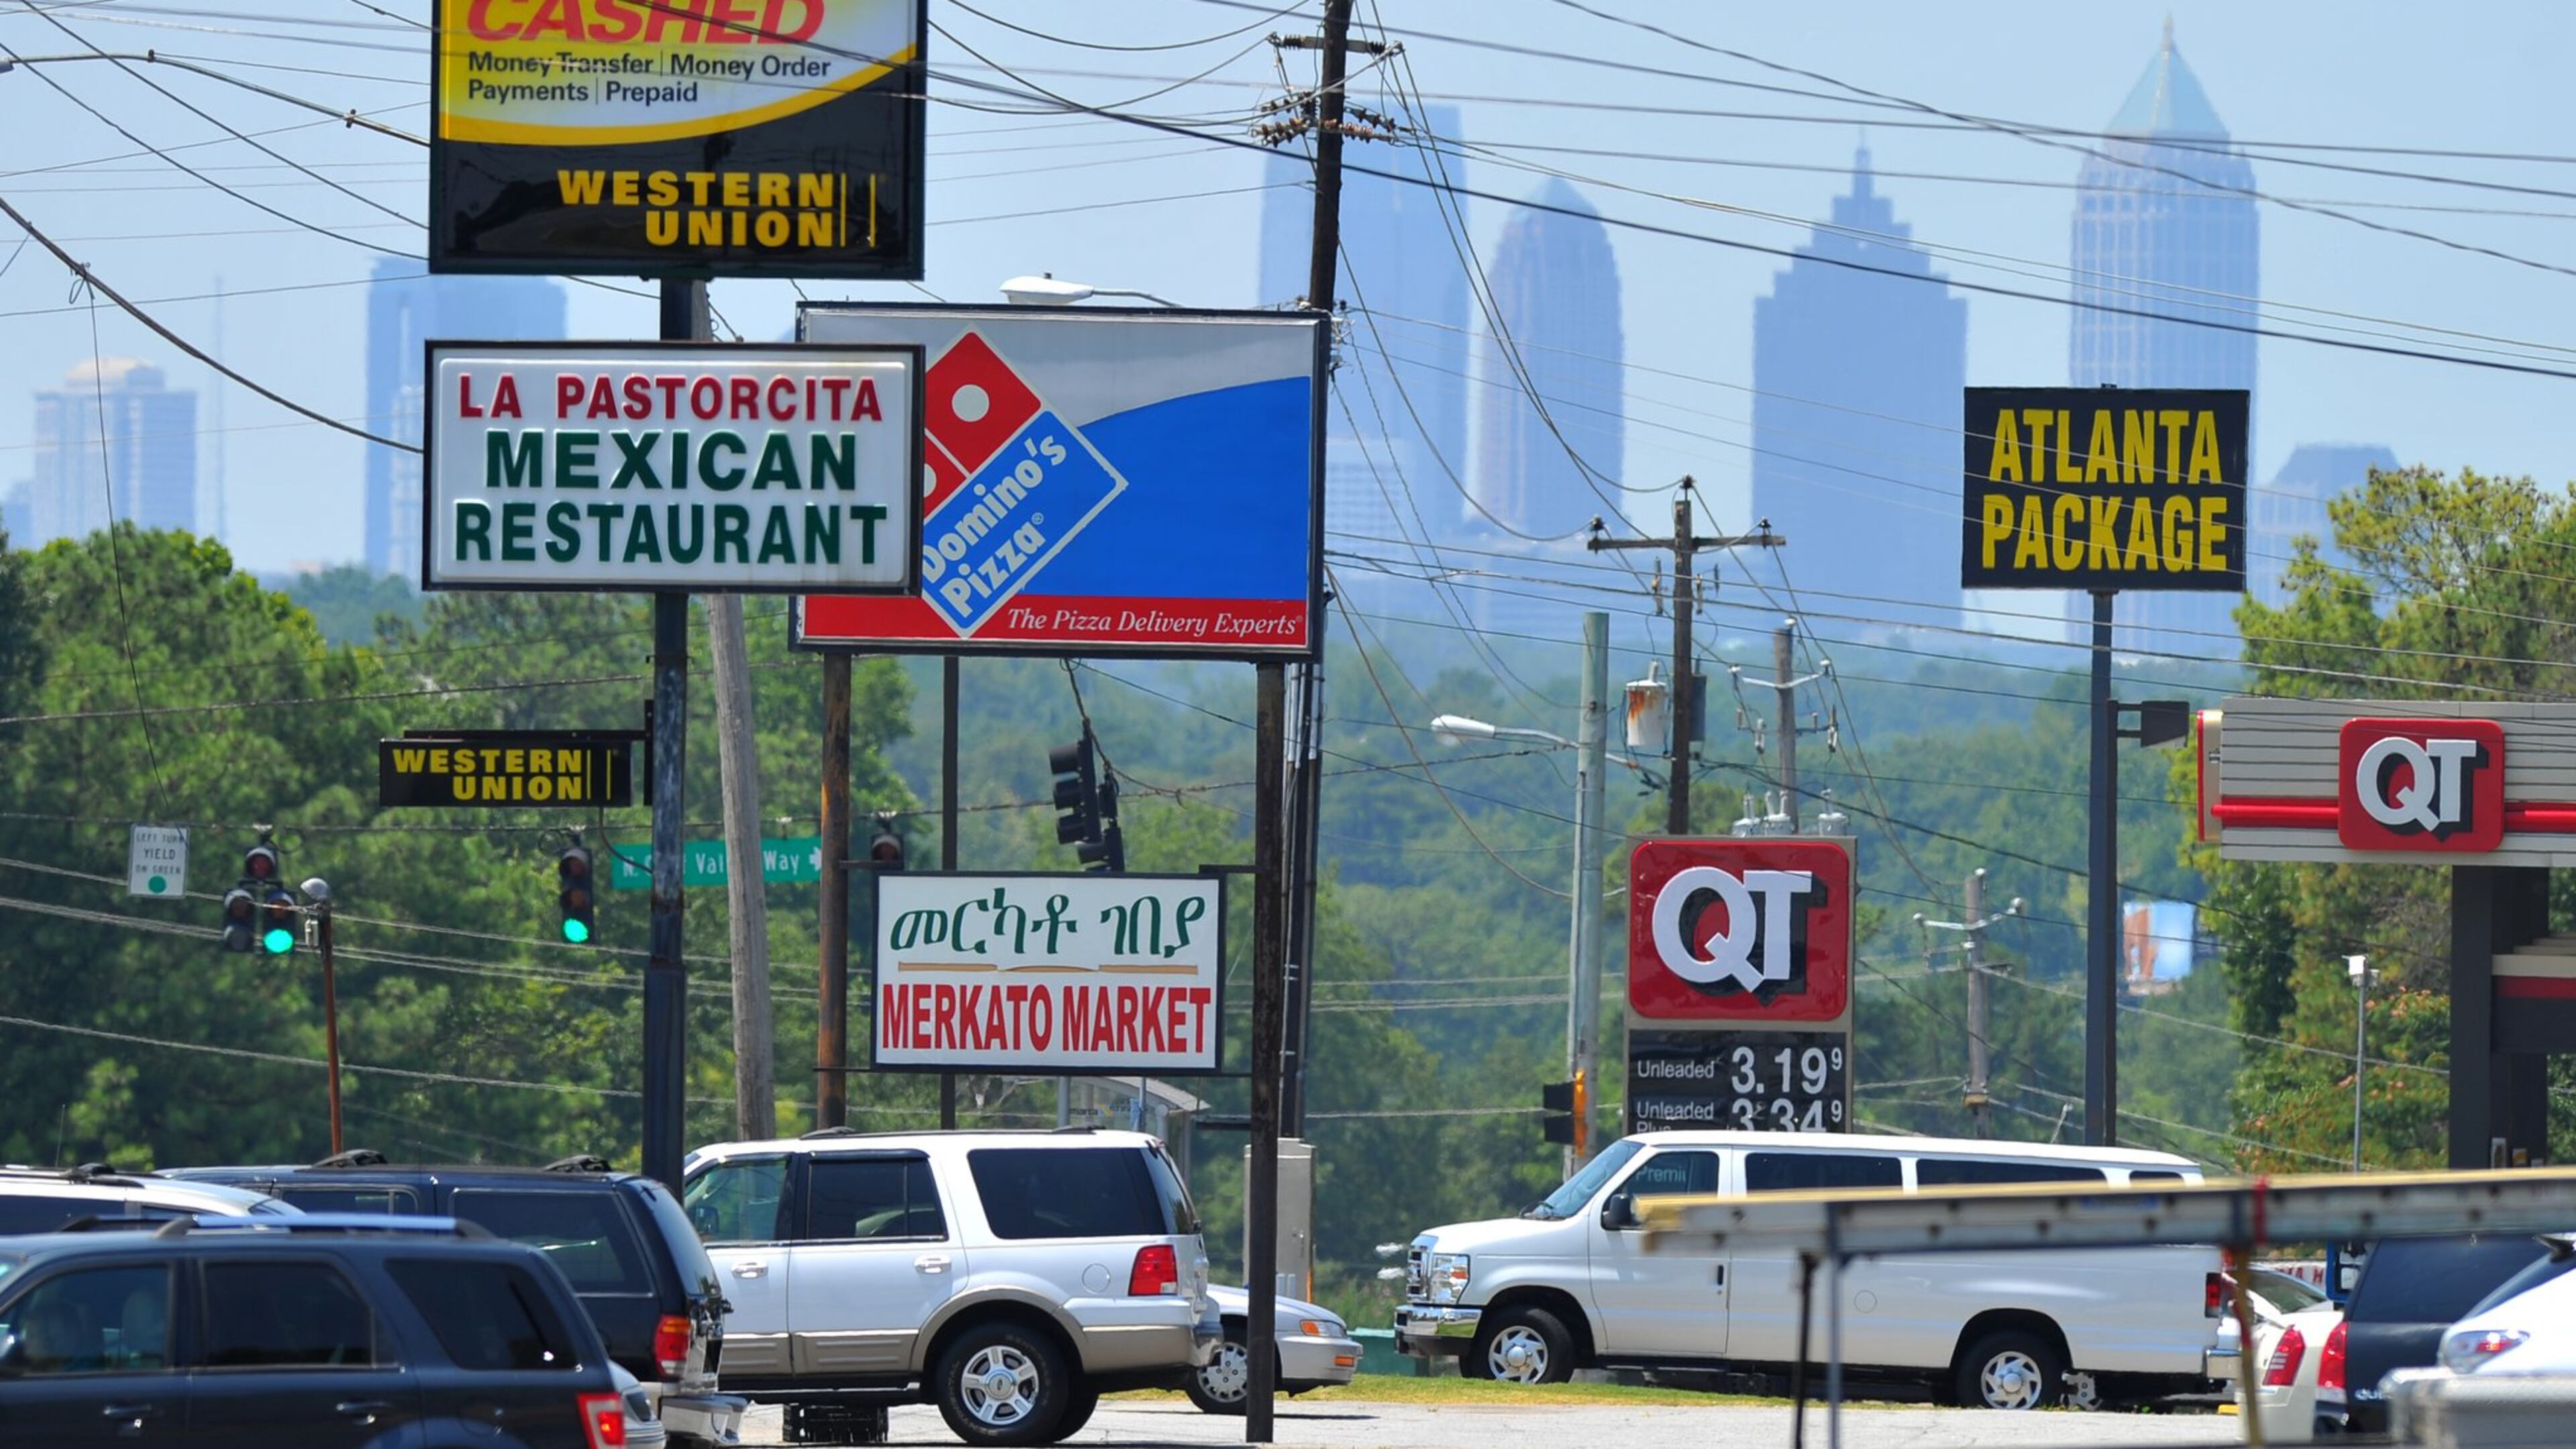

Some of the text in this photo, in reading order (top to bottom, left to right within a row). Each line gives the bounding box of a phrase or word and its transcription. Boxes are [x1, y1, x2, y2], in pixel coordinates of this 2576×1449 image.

[466, 0, 824, 44] CASHED
[468, 52, 831, 79] Money Transfer Money Order
[468, 80, 698, 106] Payments Prepaid
[557, 170, 834, 207] WESTERN
[645, 211, 833, 247] UNION
[459, 374, 883, 422] LA PASTORCITA
[486, 429, 857, 491] MEXICAN
[1988, 409, 2222, 484] ATLANTA
[922, 435, 1067, 584] Domino's
[453, 500, 888, 564] RESTAURANT
[1982, 494, 2227, 572] PACKAGE
[1008, 608, 1296, 637] The Pizza Delivery Experts
[392, 749, 582, 773] WESTERN
[453, 776, 582, 800] UNION
[2357, 736, 2477, 832] QT
[144, 848, 176, 859] YIELD
[763, 850, 799, 875] Way
[890, 888, 1205, 959] መርካቶ ገበያ
[1652, 866, 1813, 993] QT
[883, 983, 1212, 1053] MERKATO MARKET
[1638, 1060, 1715, 1078] Unleaded
[1731, 1046, 1827, 1094] 3.19
[1638, 1102, 1714, 1119] Unleaded
[1732, 1098, 1827, 1132] 334
[1635, 1166, 1686, 1182] Premi
